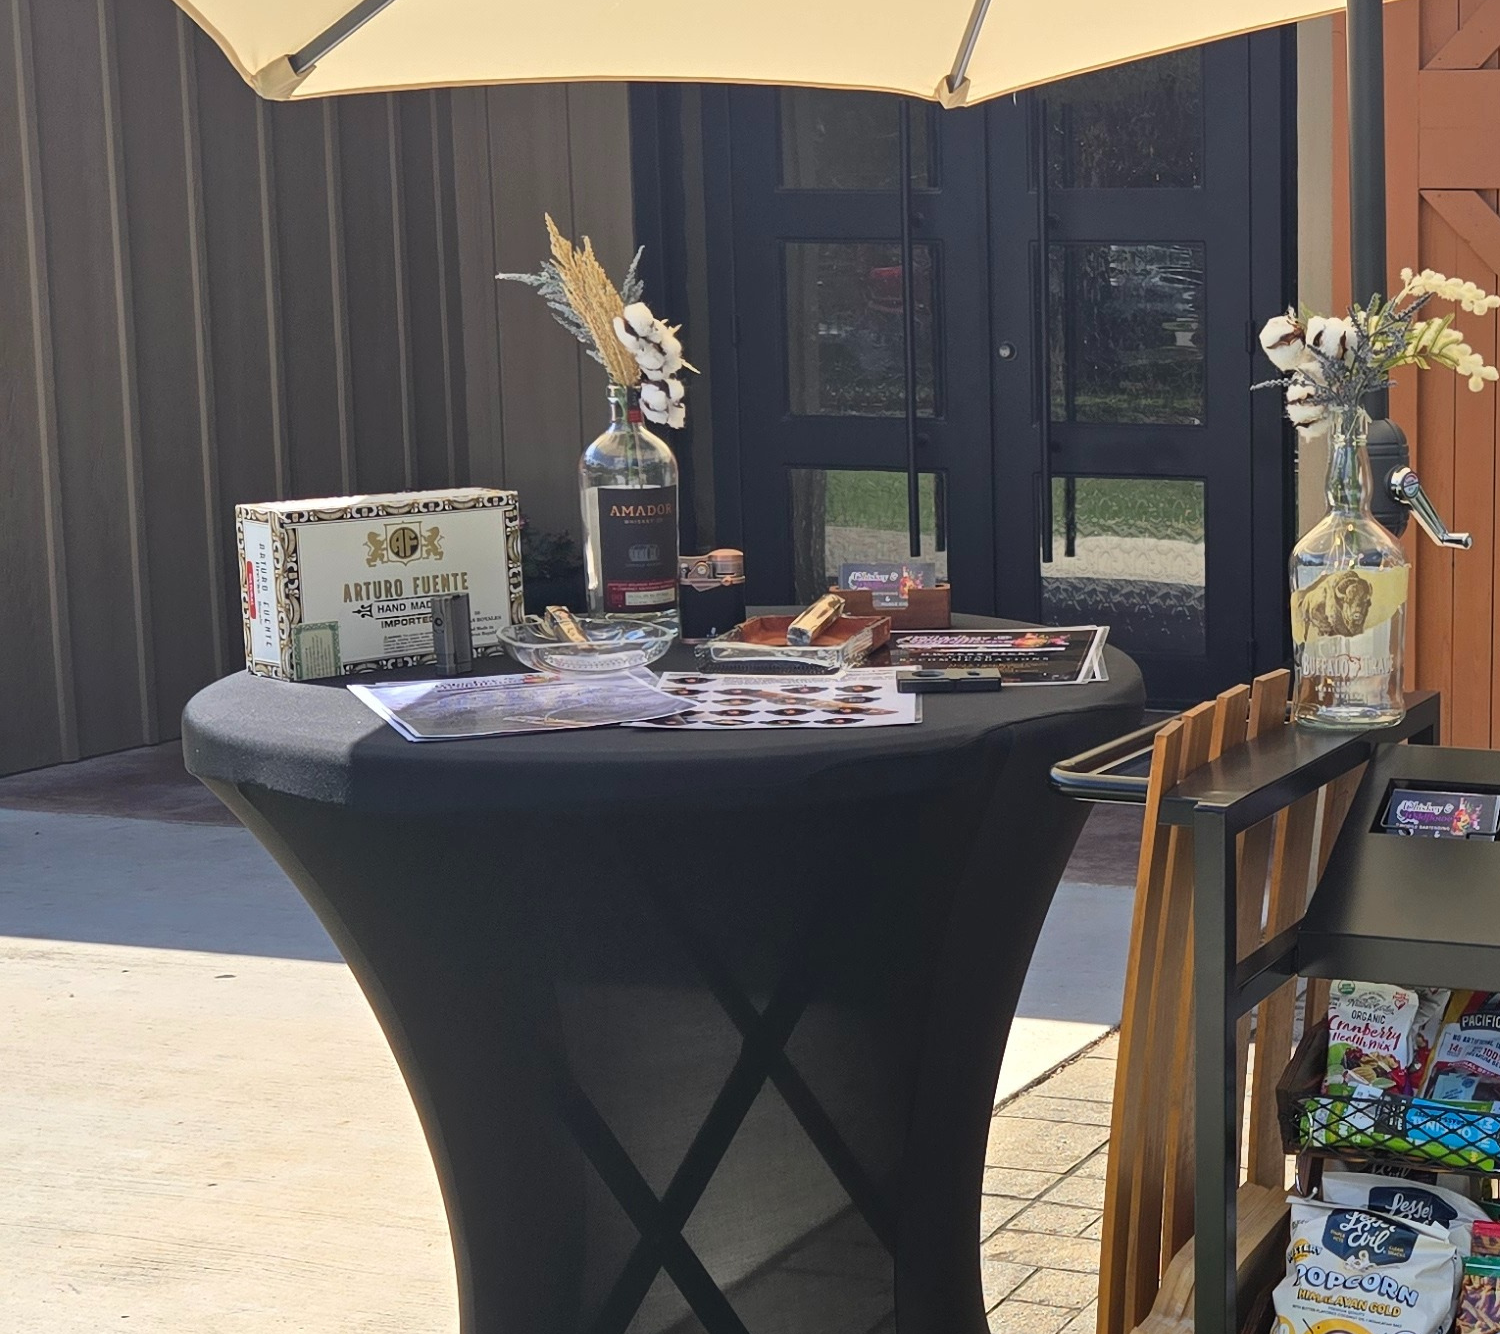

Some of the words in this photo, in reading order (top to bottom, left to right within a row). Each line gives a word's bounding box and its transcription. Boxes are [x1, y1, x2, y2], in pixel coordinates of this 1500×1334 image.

[609, 503, 673, 517] AMADOR
[343, 577, 404, 603] ARTURO
[413, 572, 469, 595] FUENTE
[377, 603, 407, 614] HAND
[410, 599, 432, 610] MAD
[1301, 653, 1348, 677] BUFFALO
[1351, 1009, 1386, 1025] ORGANIC
[1328, 1014, 1402, 1051] Cranberry
[1332, 1032, 1368, 1048] Health
[1348, 1222, 1386, 1254] Evil
[1293, 1264, 1420, 1309] POPCORN
[1297, 1289, 1368, 1313] HIMALAYAN
[1369, 1301, 1402, 1318] GOLD
